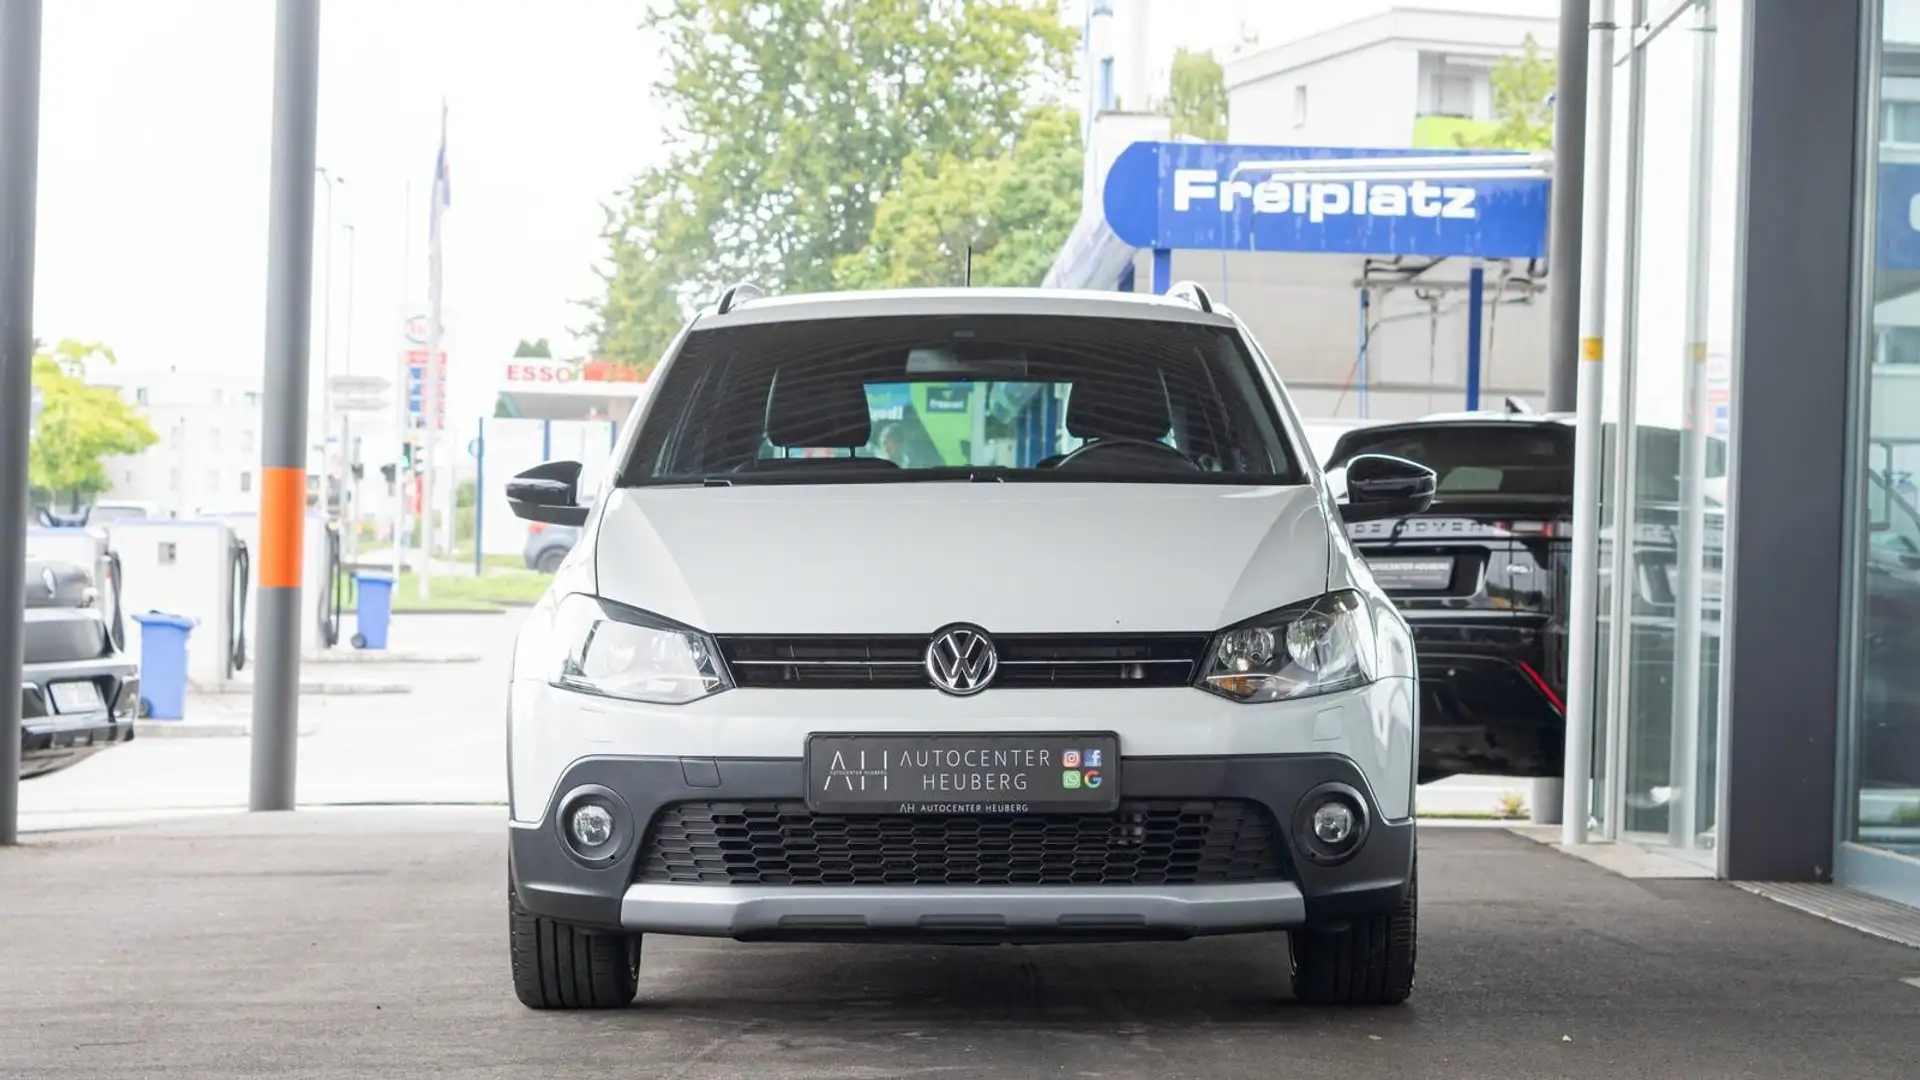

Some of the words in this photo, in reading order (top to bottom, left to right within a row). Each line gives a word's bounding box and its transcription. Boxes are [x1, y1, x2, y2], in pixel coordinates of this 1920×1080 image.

[1173, 169, 1476, 223] Freiplatz
[506, 363, 574, 383] ESSO
[900, 749, 1050, 767] AUTOCENTER
[923, 773, 1028, 790] HEUBERG
[920, 803, 982, 813] AUTOCENTER
[985, 803, 1029, 813] HEUBERG
